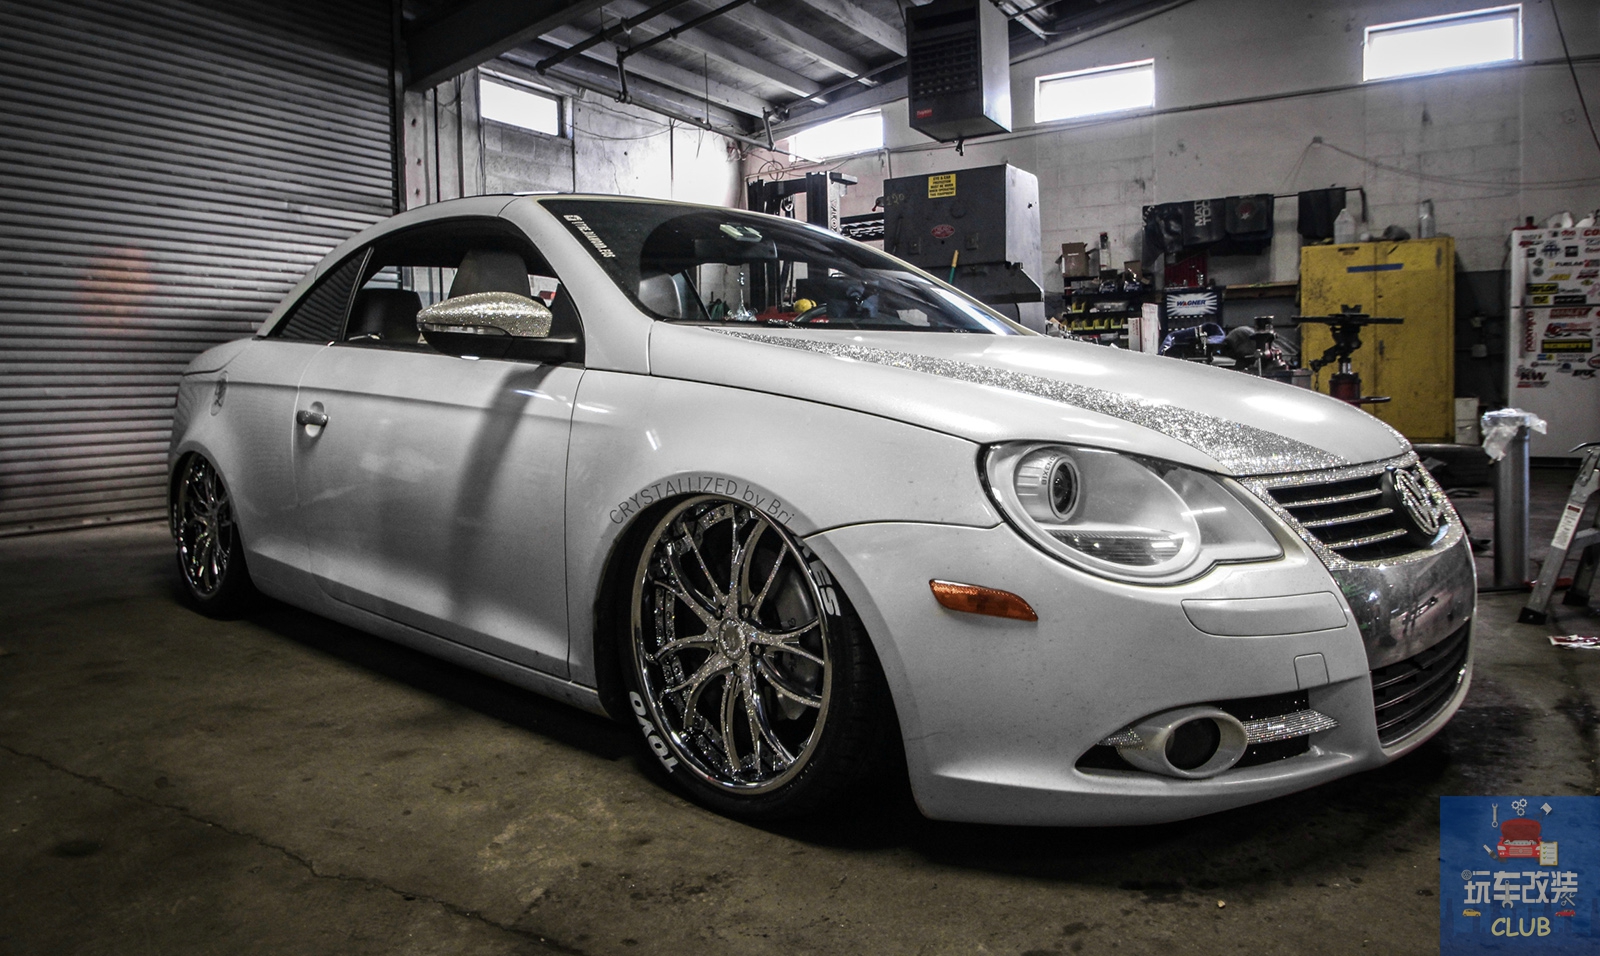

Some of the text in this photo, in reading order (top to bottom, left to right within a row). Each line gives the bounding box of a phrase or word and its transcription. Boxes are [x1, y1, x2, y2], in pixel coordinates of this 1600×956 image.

[609, 476, 796, 526] CRYSTALLIZED by Bri
[629, 691, 680, 774] TOYO
